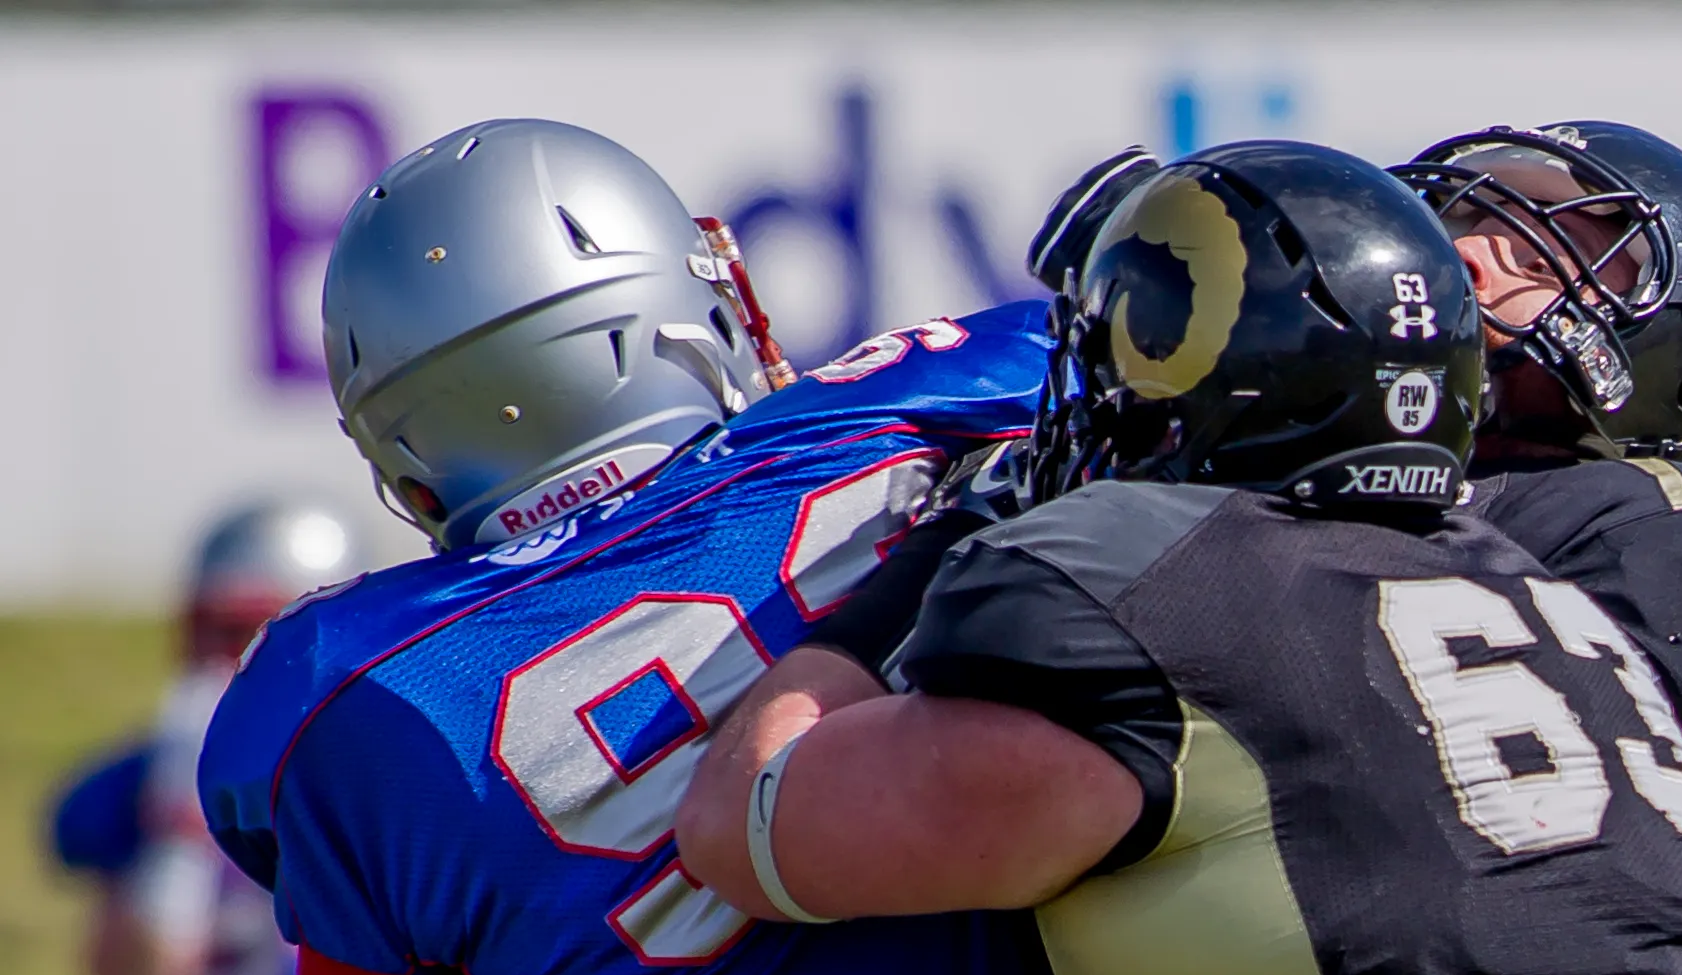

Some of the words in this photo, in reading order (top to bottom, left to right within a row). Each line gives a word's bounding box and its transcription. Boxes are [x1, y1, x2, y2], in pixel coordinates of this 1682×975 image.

[1392, 273, 1428, 303] 63
[1398, 385, 1428, 407] RW
[1402, 410, 1420, 427] 85
[1338, 465, 1452, 494] XENITH
[498, 459, 625, 536] Riddell
